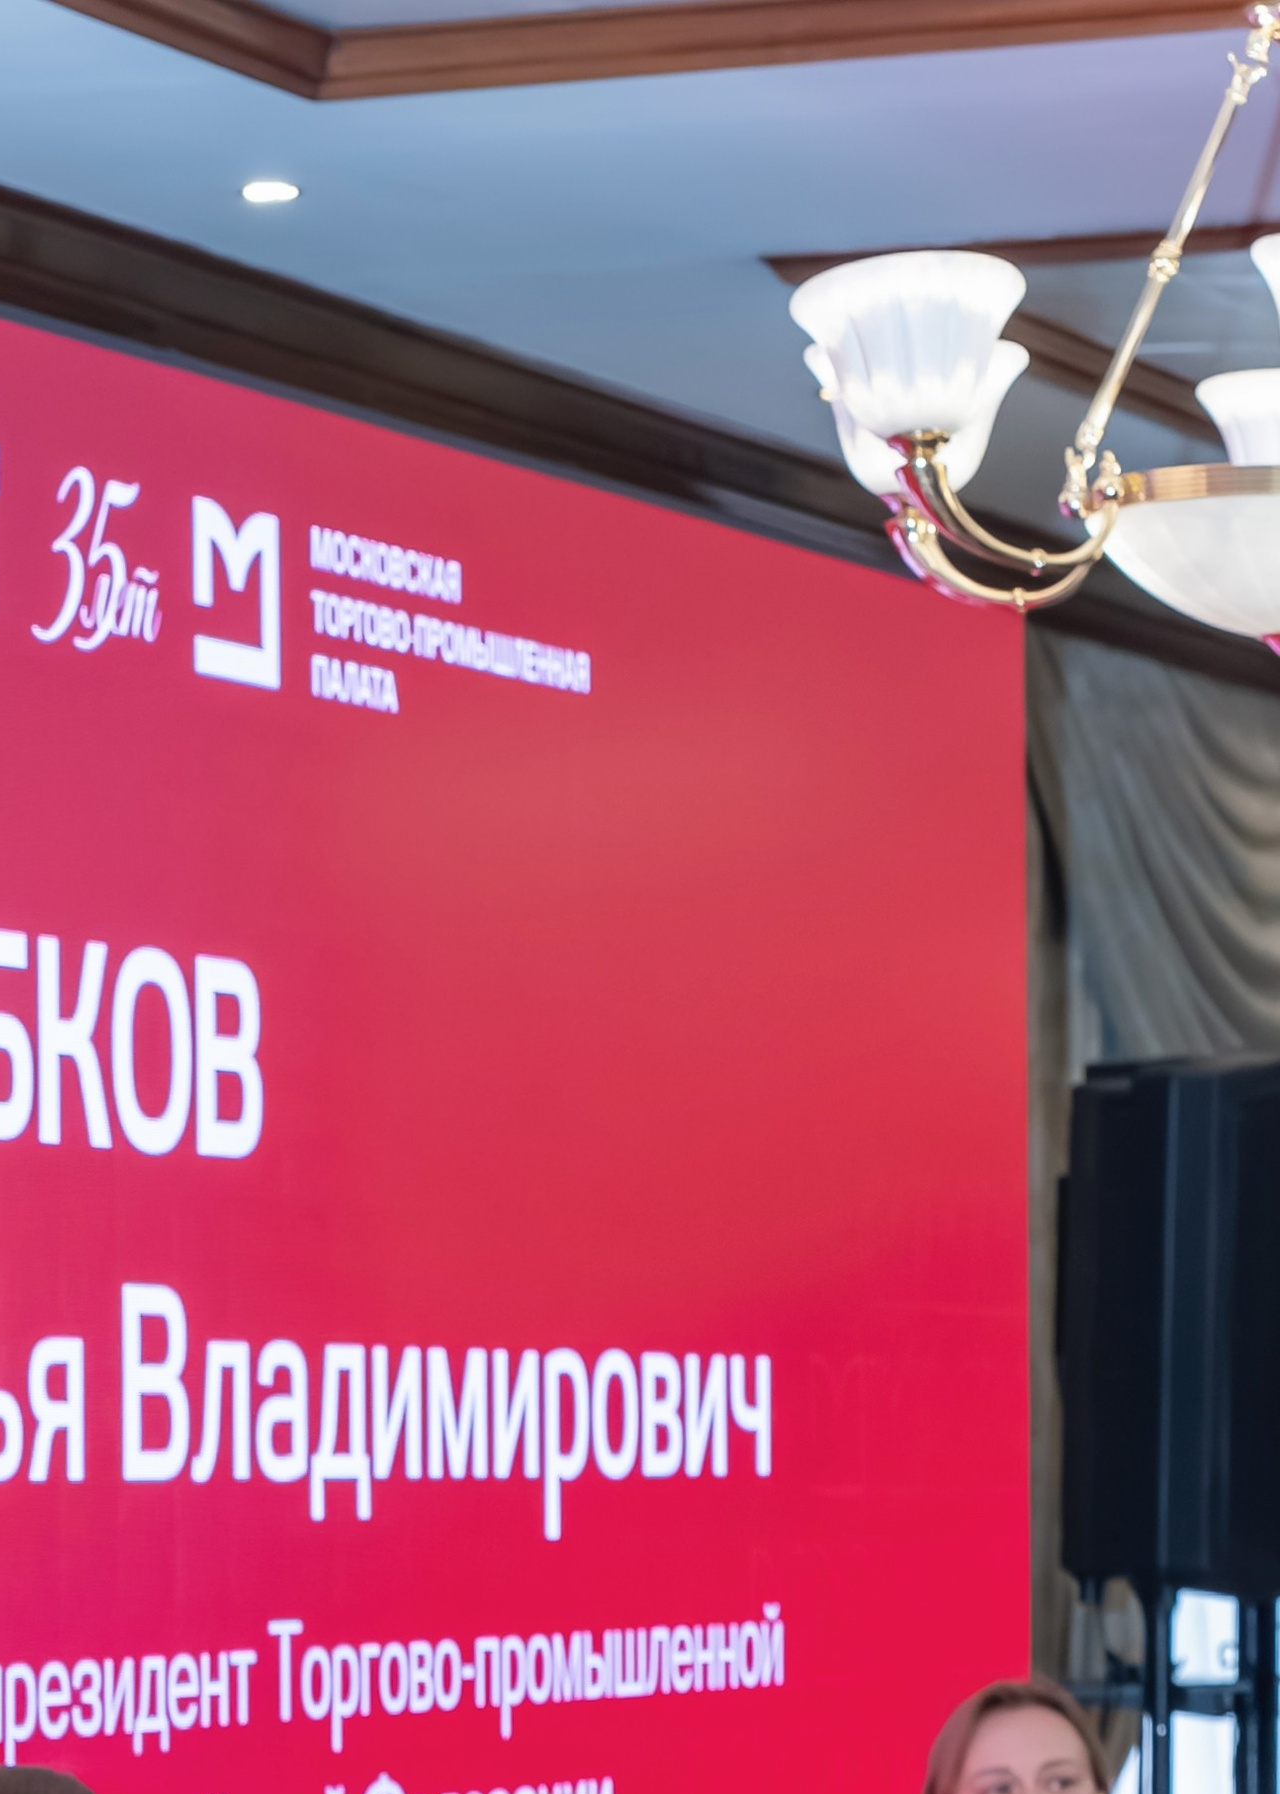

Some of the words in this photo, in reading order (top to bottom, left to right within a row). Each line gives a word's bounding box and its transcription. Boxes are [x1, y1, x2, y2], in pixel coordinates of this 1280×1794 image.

[30, 465, 141, 653] 35
[309, 525, 462, 605] МОСКОВСКАЯ
[309, 588, 592, 695] ТОРГОВО-ПРОМЫШЛЕННАЯ
[310, 653, 400, 715] ПАЛАТА
[121, 1282, 772, 1541] Владимирович
[266, 1601, 785, 1753] Торгово-промышленной
